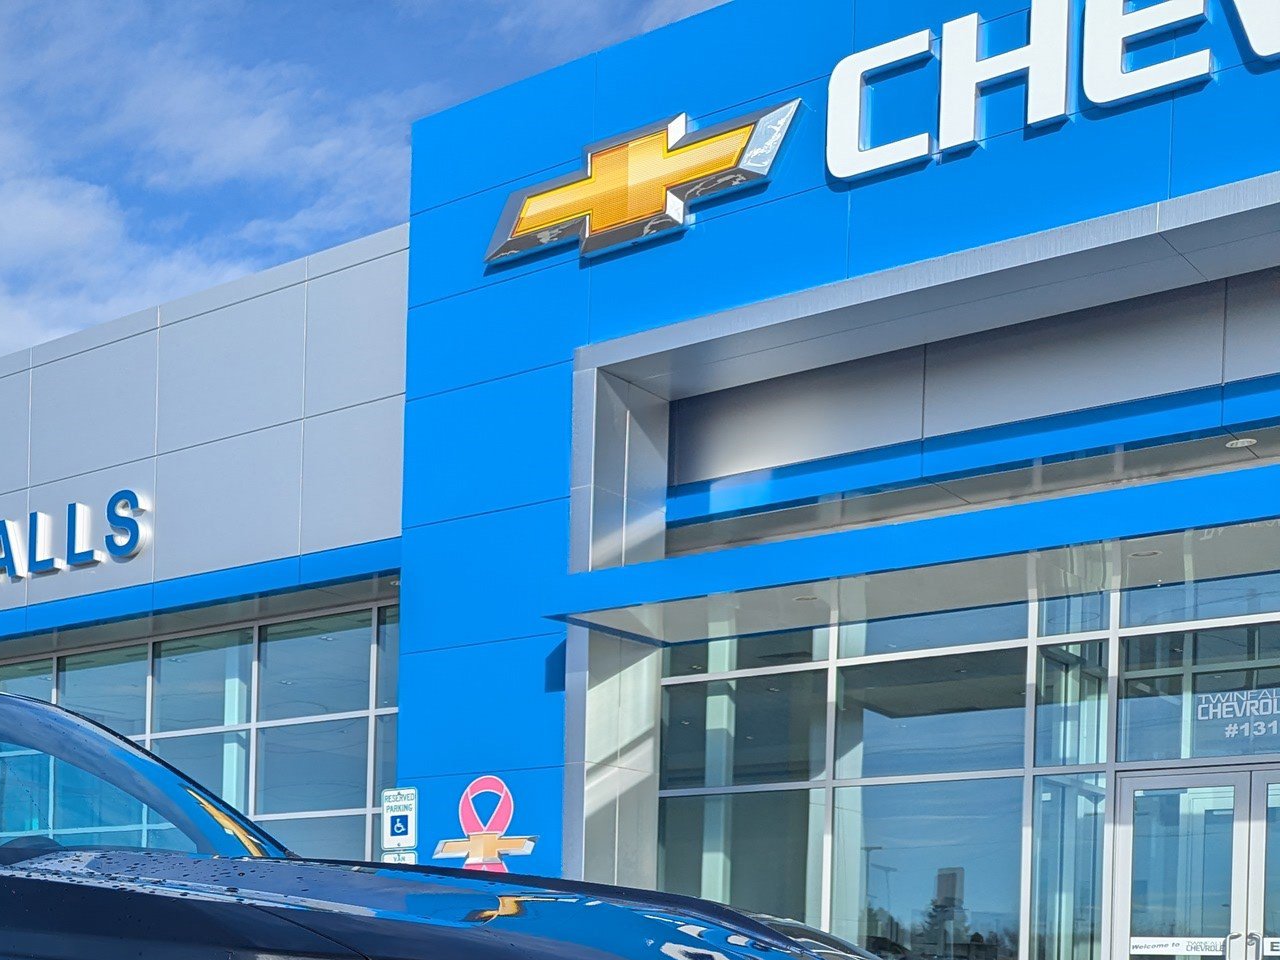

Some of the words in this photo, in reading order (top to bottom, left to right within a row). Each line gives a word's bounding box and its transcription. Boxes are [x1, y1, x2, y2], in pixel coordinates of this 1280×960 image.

[1197, 698, 1280, 720] CHEVROL
[384, 792, 415, 802] RESERVED
[386, 803, 413, 813] PARKING
